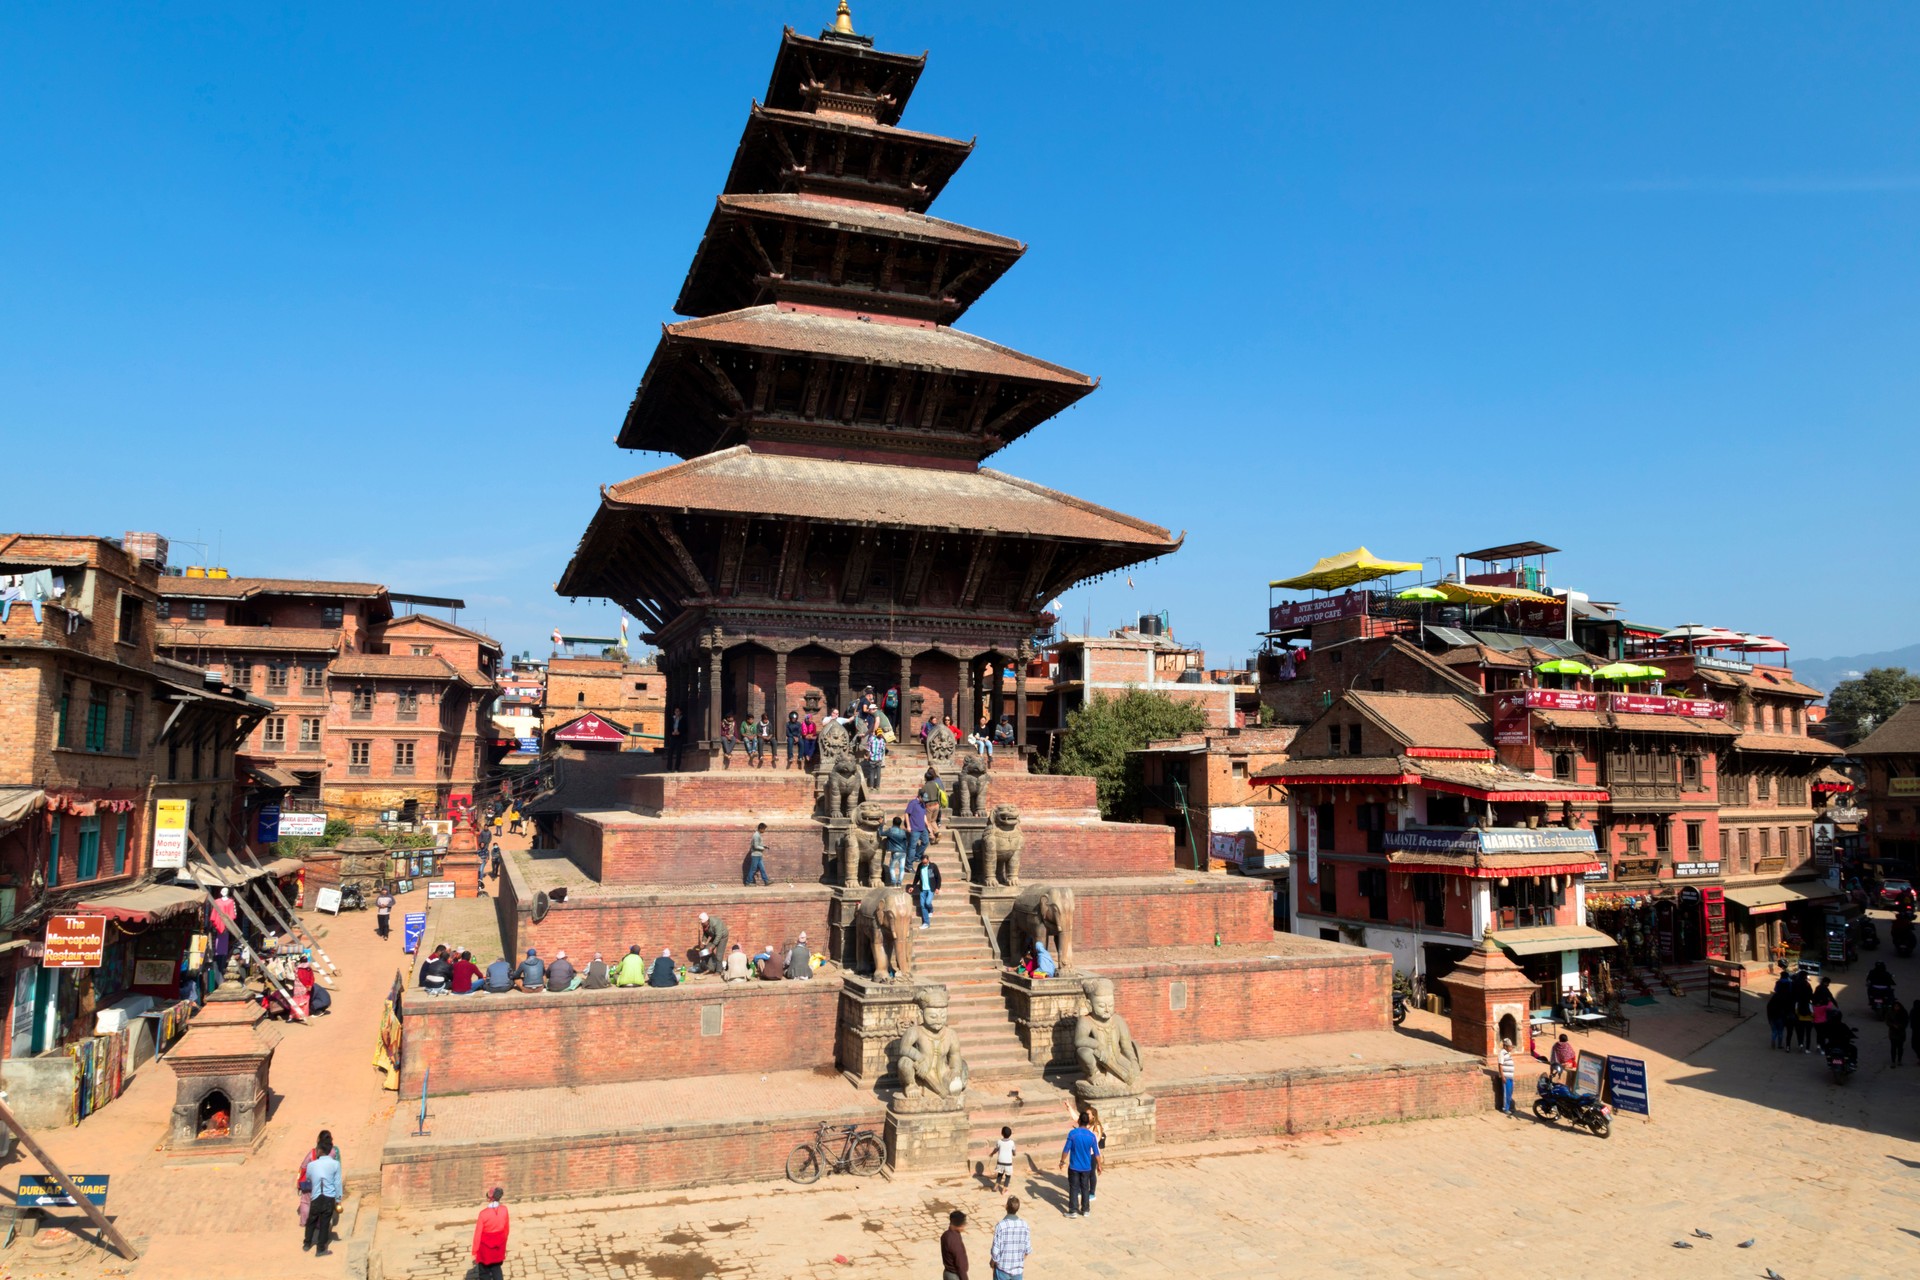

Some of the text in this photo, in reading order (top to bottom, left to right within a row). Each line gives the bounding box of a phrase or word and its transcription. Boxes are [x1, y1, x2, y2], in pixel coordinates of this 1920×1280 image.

[157, 839, 181, 849] Money
[1384, 832, 1477, 849] NAMASTE Restaurant
[1482, 834, 1595, 849] NAMASTE Restaurant
[155, 849, 181, 859] Exchange
[65, 917, 85, 930] The
[47, 933, 101, 950] Marcopolo
[45, 949, 101, 961] Restaurant
[1611, 1064, 1626, 1074] Guest
[1626, 1066, 1643, 1076] House
[44, 1176, 85, 1184] WA TO
[19, 1185, 63, 1196] DURBAR
